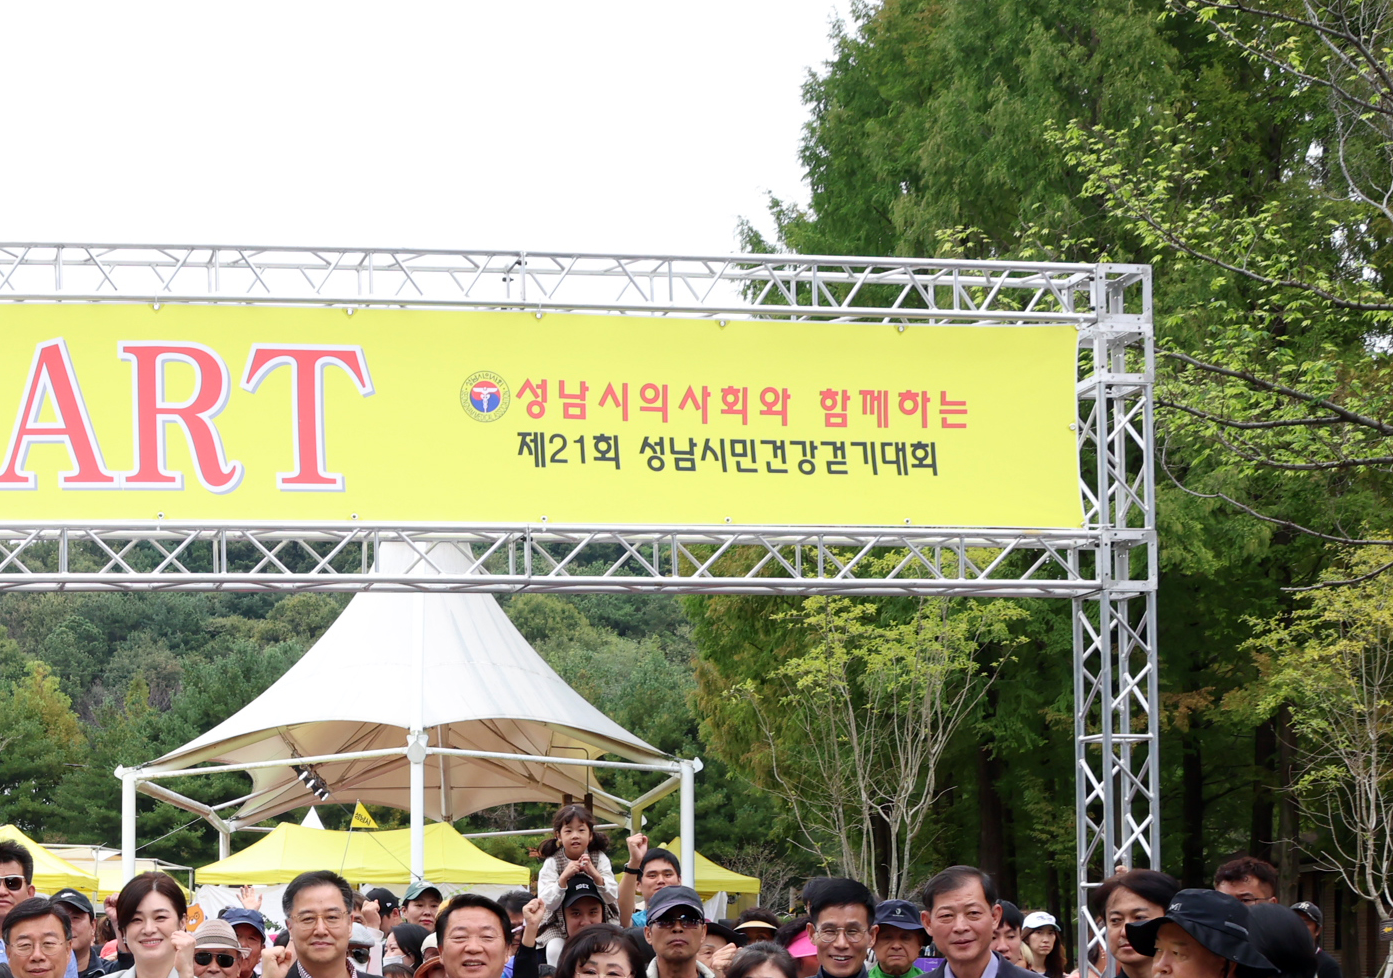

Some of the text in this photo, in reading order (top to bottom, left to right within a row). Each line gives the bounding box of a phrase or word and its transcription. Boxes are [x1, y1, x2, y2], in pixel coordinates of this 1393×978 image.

[516, 378, 791, 427] 성남시의사회와
[819, 388, 968, 429] 함께하는
[517, 431, 939, 477] 제21회 성남시민건강걷기대회
